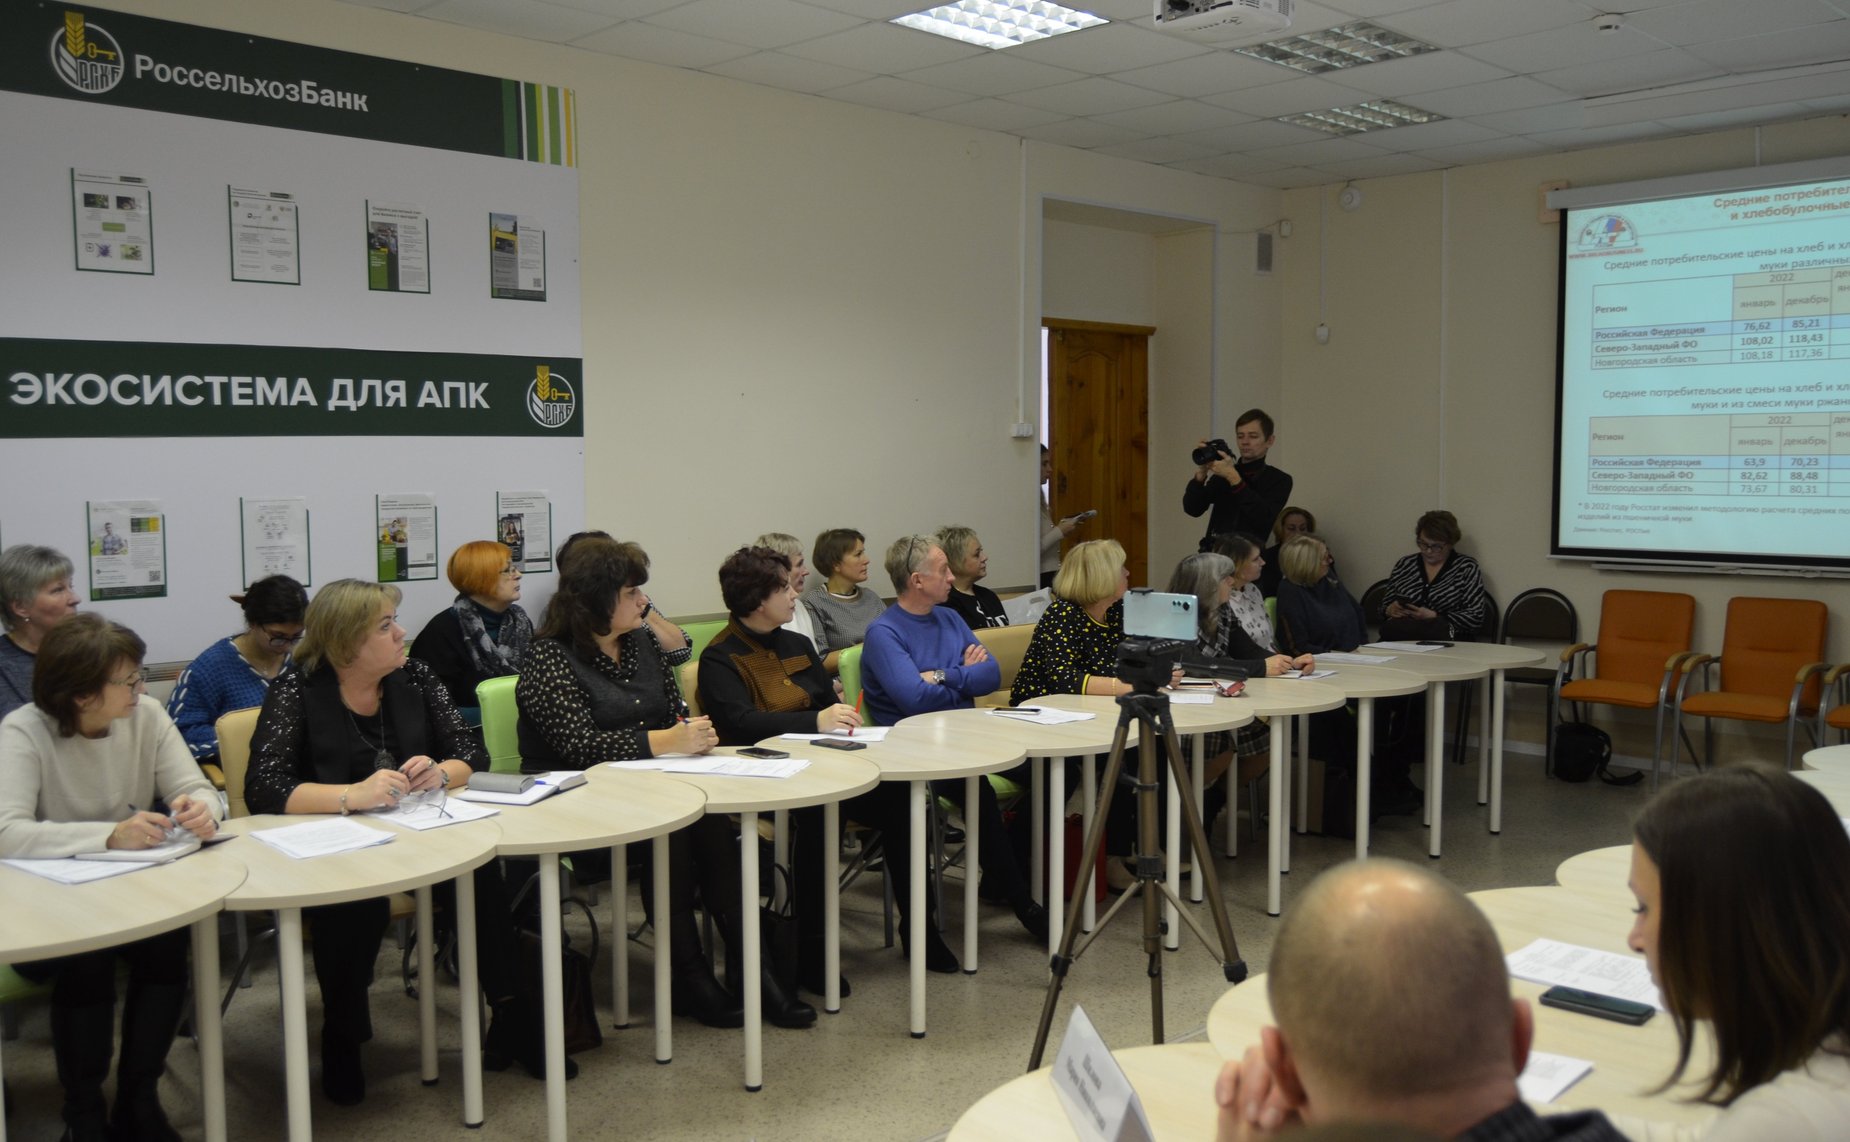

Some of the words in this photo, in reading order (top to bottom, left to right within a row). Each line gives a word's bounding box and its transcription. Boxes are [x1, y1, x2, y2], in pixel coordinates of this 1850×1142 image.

[133, 53, 369, 112] РоссельхозБанк
[1713, 194, 1770, 210] Средние
[1730, 212, 1739, 221] и
[1742, 200, 1850, 220] хлебобулочные
[1603, 258, 1648, 271] Средние
[1651, 250, 1744, 267] потребительские
[1747, 248, 1777, 258] цены
[1780, 246, 1794, 255] на
[1797, 241, 1825, 253] хлеб
[1828, 242, 1836, 251] и
[1759, 262, 1788, 272] муки
[1769, 273, 1794, 283] 2022
[1595, 305, 1627, 313] Регион
[1740, 299, 1776, 308] январь
[1785, 294, 1829, 306] декабрь
[1595, 329, 1648, 339] Российская
[1650, 327, 1705, 337] Федерация
[1744, 321, 1771, 332] 76,62
[1792, 318, 1820, 329] 85,21
[1595, 341, 1679, 353] Северо-Западный
[1681, 340, 1698, 348] ФО
[1741, 336, 1774, 346] 108,02
[1789, 334, 1823, 344] 118,43
[1595, 357, 1658, 367] Новгородская
[1660, 355, 1698, 365] область
[1740, 351, 1773, 361] 108,18
[1789, 348, 1822, 359] 117,36
[9, 372, 318, 406] ЭКОСИСТЕМА
[328, 378, 407, 411] ДЛЯ
[417, 380, 490, 409] АПК
[1603, 389, 1646, 400] Средние
[1650, 386, 1742, 398] потребительские
[1745, 386, 1775, 395] цены
[1778, 385, 1792, 393] на
[1794, 381, 1823, 393] хлеб
[1826, 383, 1833, 391] и
[1691, 401, 1719, 411] муки
[1746, 400, 1781, 408] смеси
[1784, 399, 1813, 408] муки
[1768, 416, 1792, 425] 2022
[1592, 433, 1624, 441] Регион
[1738, 439, 1773, 447] январь
[1783, 436, 1827, 447] декабрь
[1592, 458, 1645, 466] Российская
[1646, 458, 1701, 467] Федерация
[1744, 458, 1766, 467] 63,9
[1791, 457, 1819, 467] 70,23
[1592, 471, 1675, 480] Северо-Западный
[1677, 471, 1694, 479] ФО
[1740, 471, 1768, 481] 82,62
[1790, 471, 1818, 481] 88,48
[1591, 483, 1654, 493] Новгородская
[1656, 483, 1694, 492] область
[1790, 485, 1817, 494] 80,31
[1612, 504, 1628, 512] году
